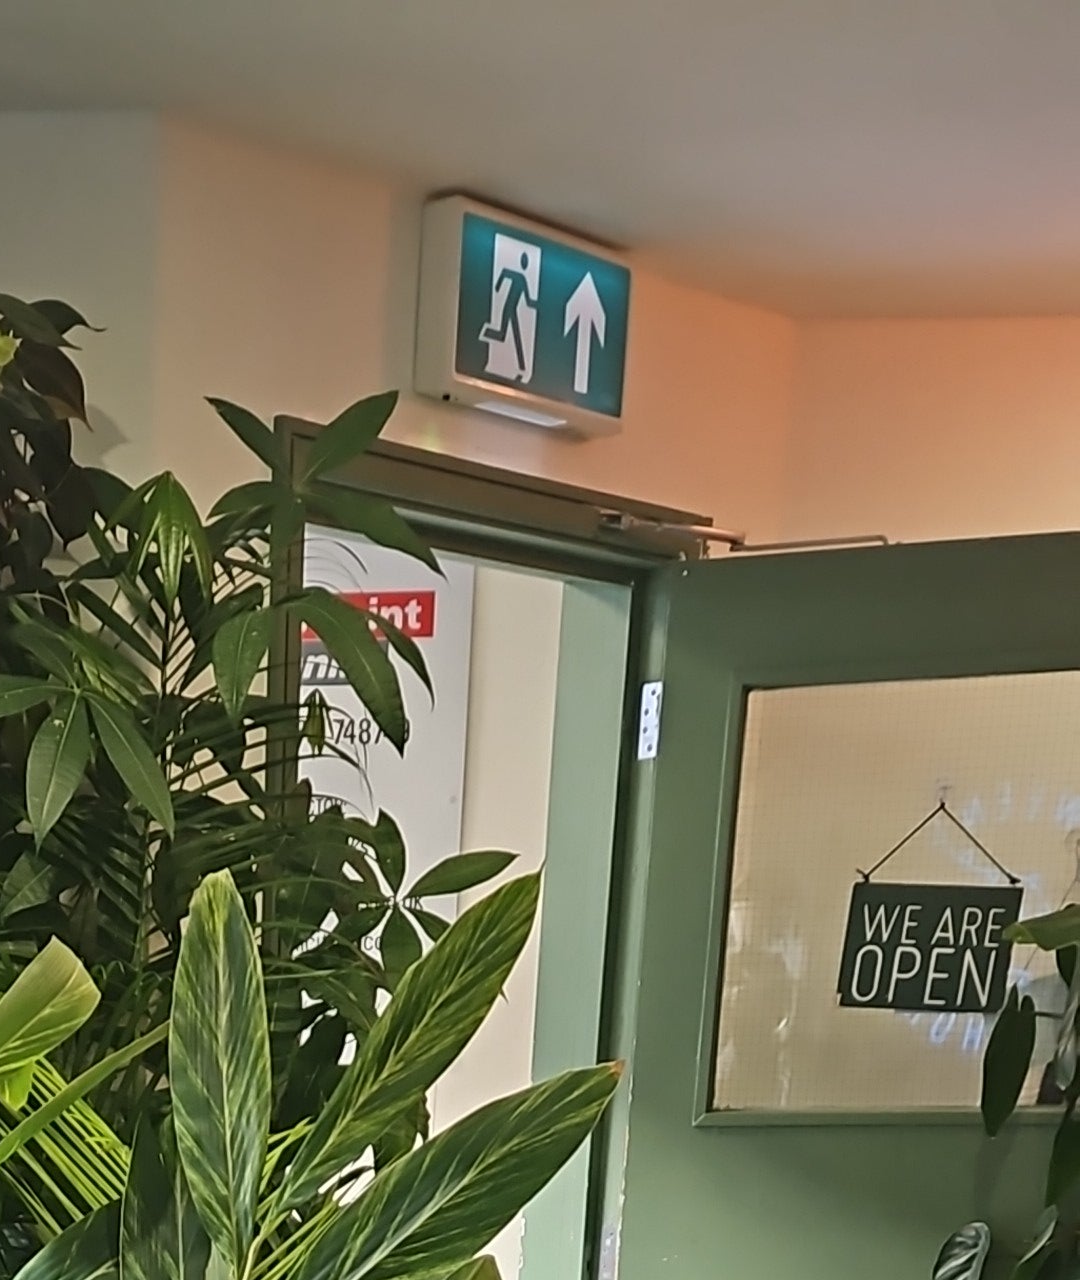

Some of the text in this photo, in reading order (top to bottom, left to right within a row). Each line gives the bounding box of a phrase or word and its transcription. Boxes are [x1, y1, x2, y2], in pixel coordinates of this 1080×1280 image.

[368, 596, 422, 630] int
[863, 903, 1006, 948] WE ARE
[851, 944, 996, 1008] OPEN
